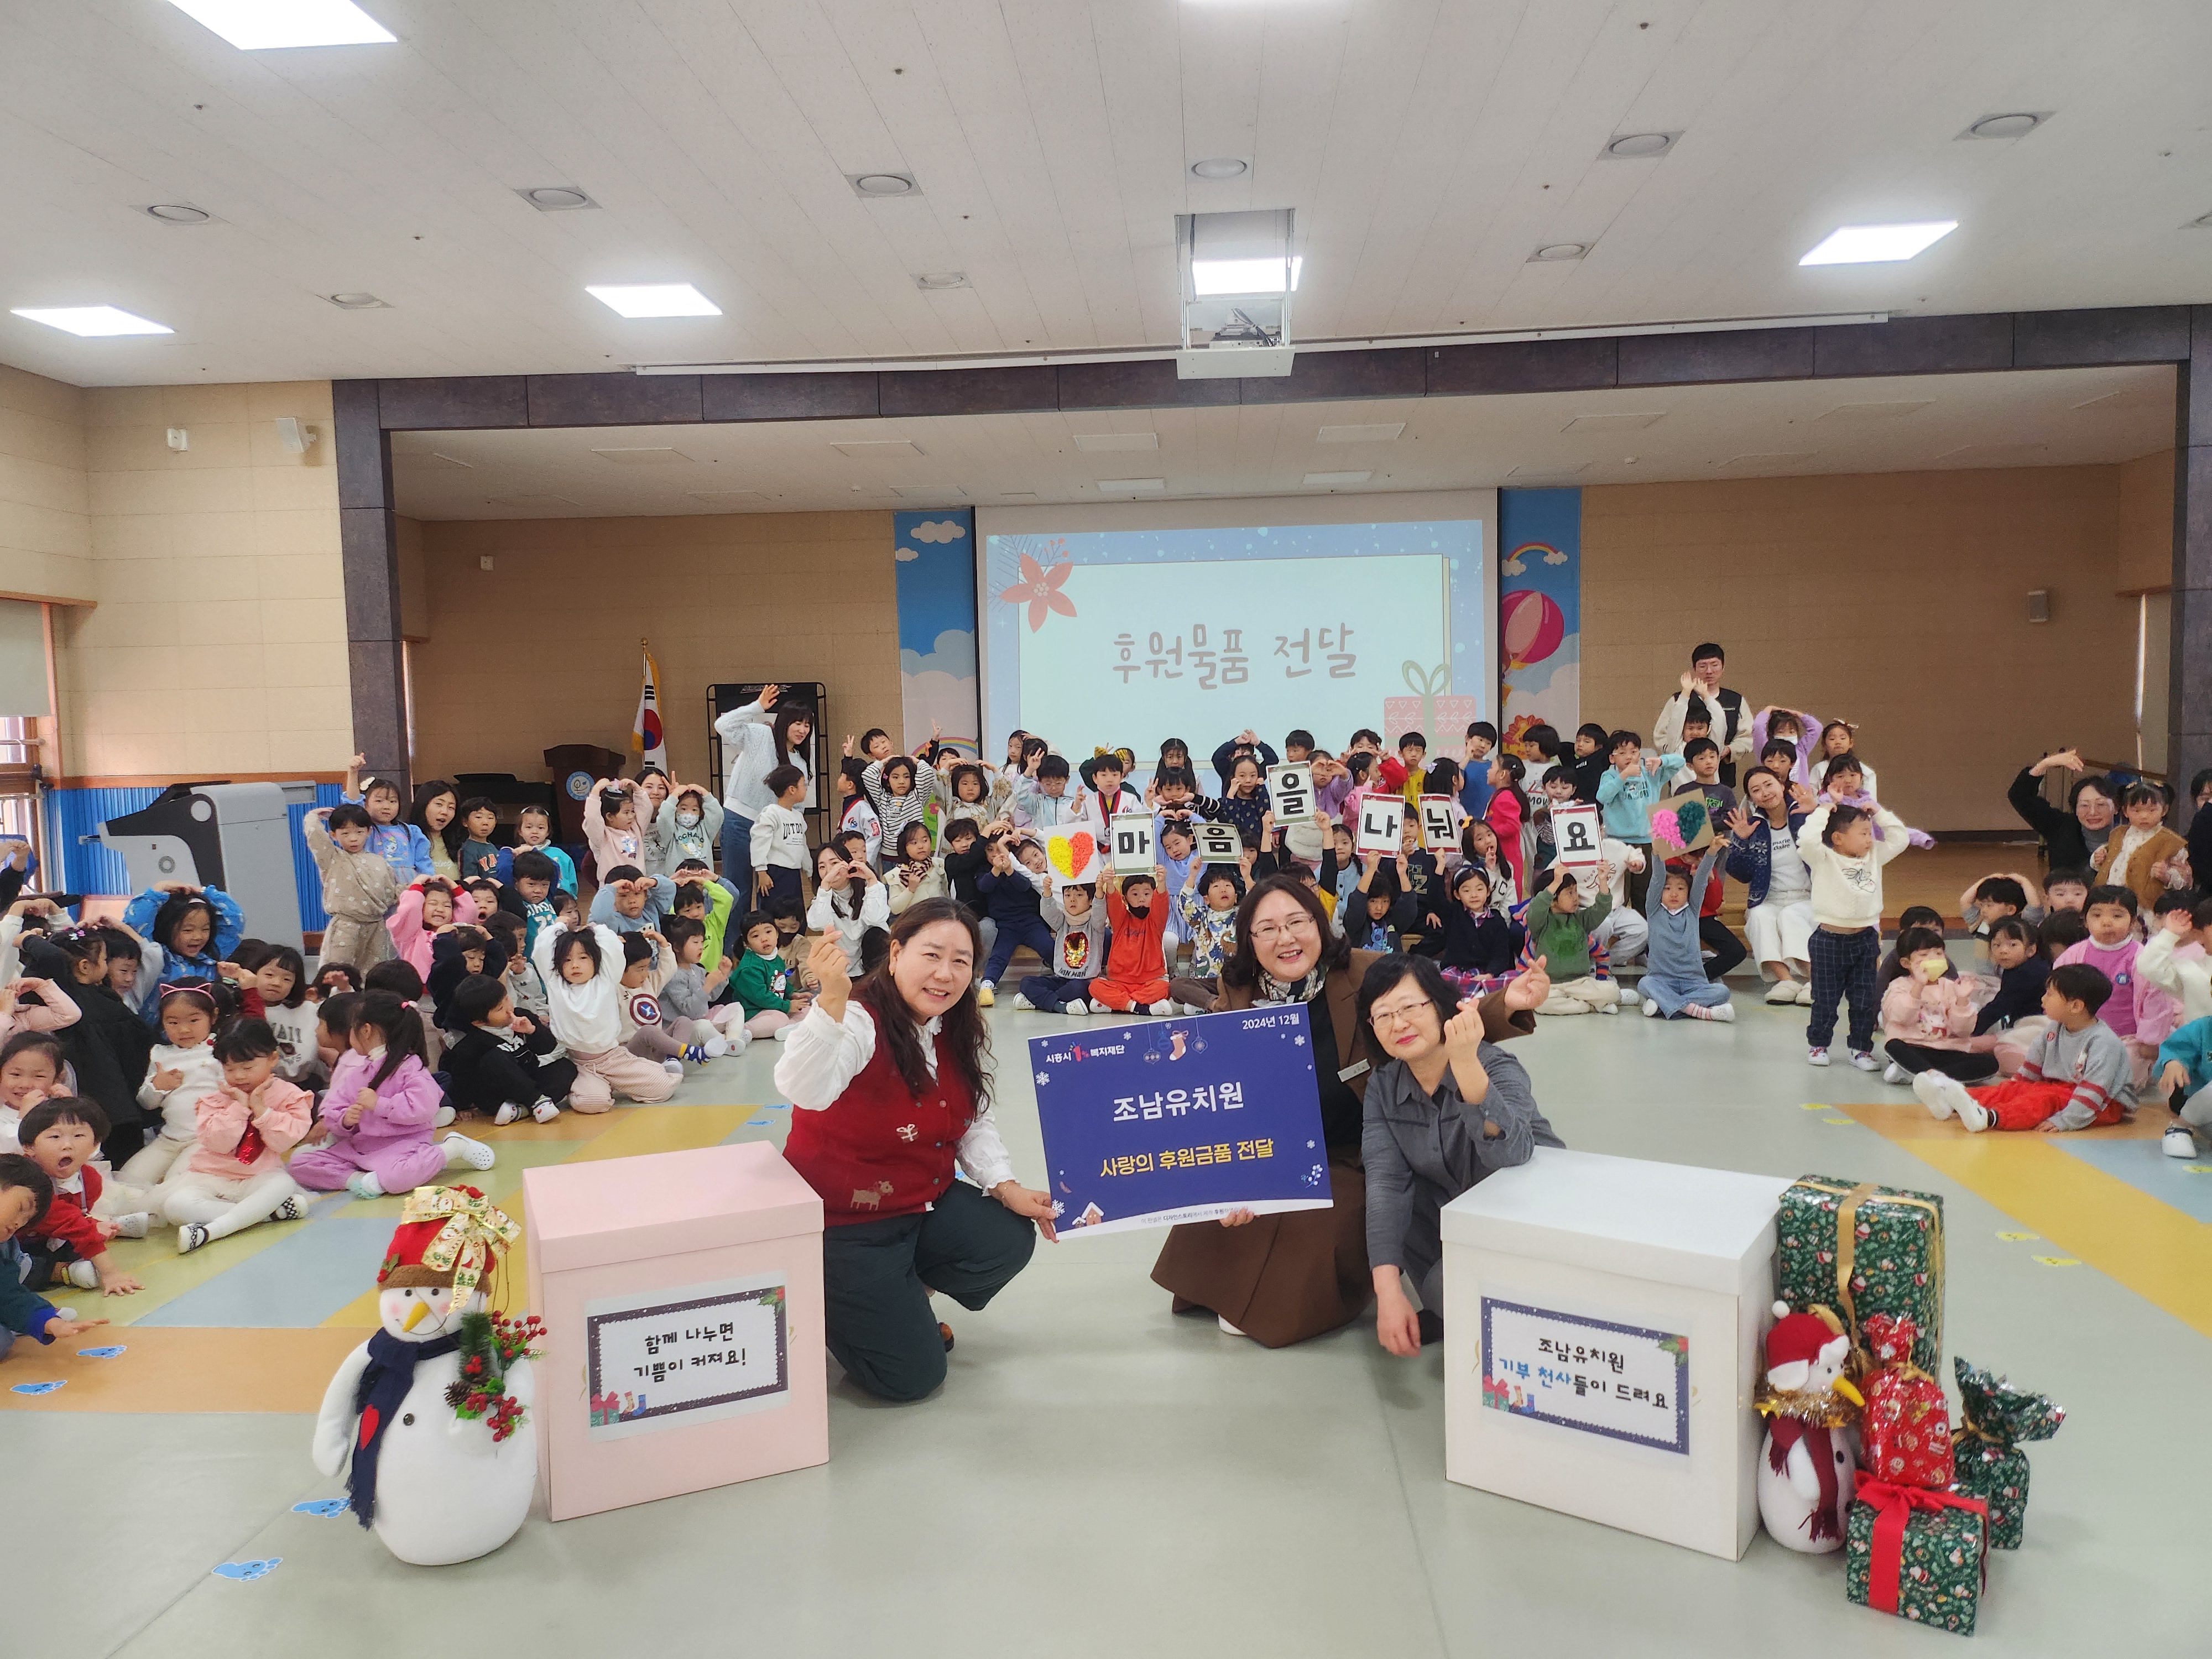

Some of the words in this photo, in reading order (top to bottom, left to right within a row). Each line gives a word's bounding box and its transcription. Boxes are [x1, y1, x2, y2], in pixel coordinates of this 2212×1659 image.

[1112, 623, 1249, 691] 후원물품
[1273, 622, 1357, 680] 전달
[1118, 831, 1150, 854] 마
[1202, 827, 1234, 853] 음
[1276, 773, 1308, 816] 을
[1364, 812, 1398, 838] 나
[1563, 821, 1596, 852] 요
[1241, 1016, 1276, 1030] 2024년
[1279, 1013, 1300, 1027] 12월
[1046, 1051, 1072, 1063] 시흥시
[1113, 1081, 1244, 1122] 조남유치원
[1100, 1152, 1154, 1178] 사랑의
[1159, 1142, 1232, 1170] 후원금품
[1237, 1138, 1274, 1160] 전달
[645, 1332, 677, 1355] 함께
[685, 1322, 734, 1342] 나누면
[1538, 1337, 1624, 1374] 조남유치원
[633, 1359, 684, 1383] 기쁨이
[691, 1348, 747, 1368] 커져요!
[1499, 1358, 1530, 1380] 기부
[1537, 1366, 1606, 1397] 천사들이
[1615, 1383, 1669, 1410] 드려요
